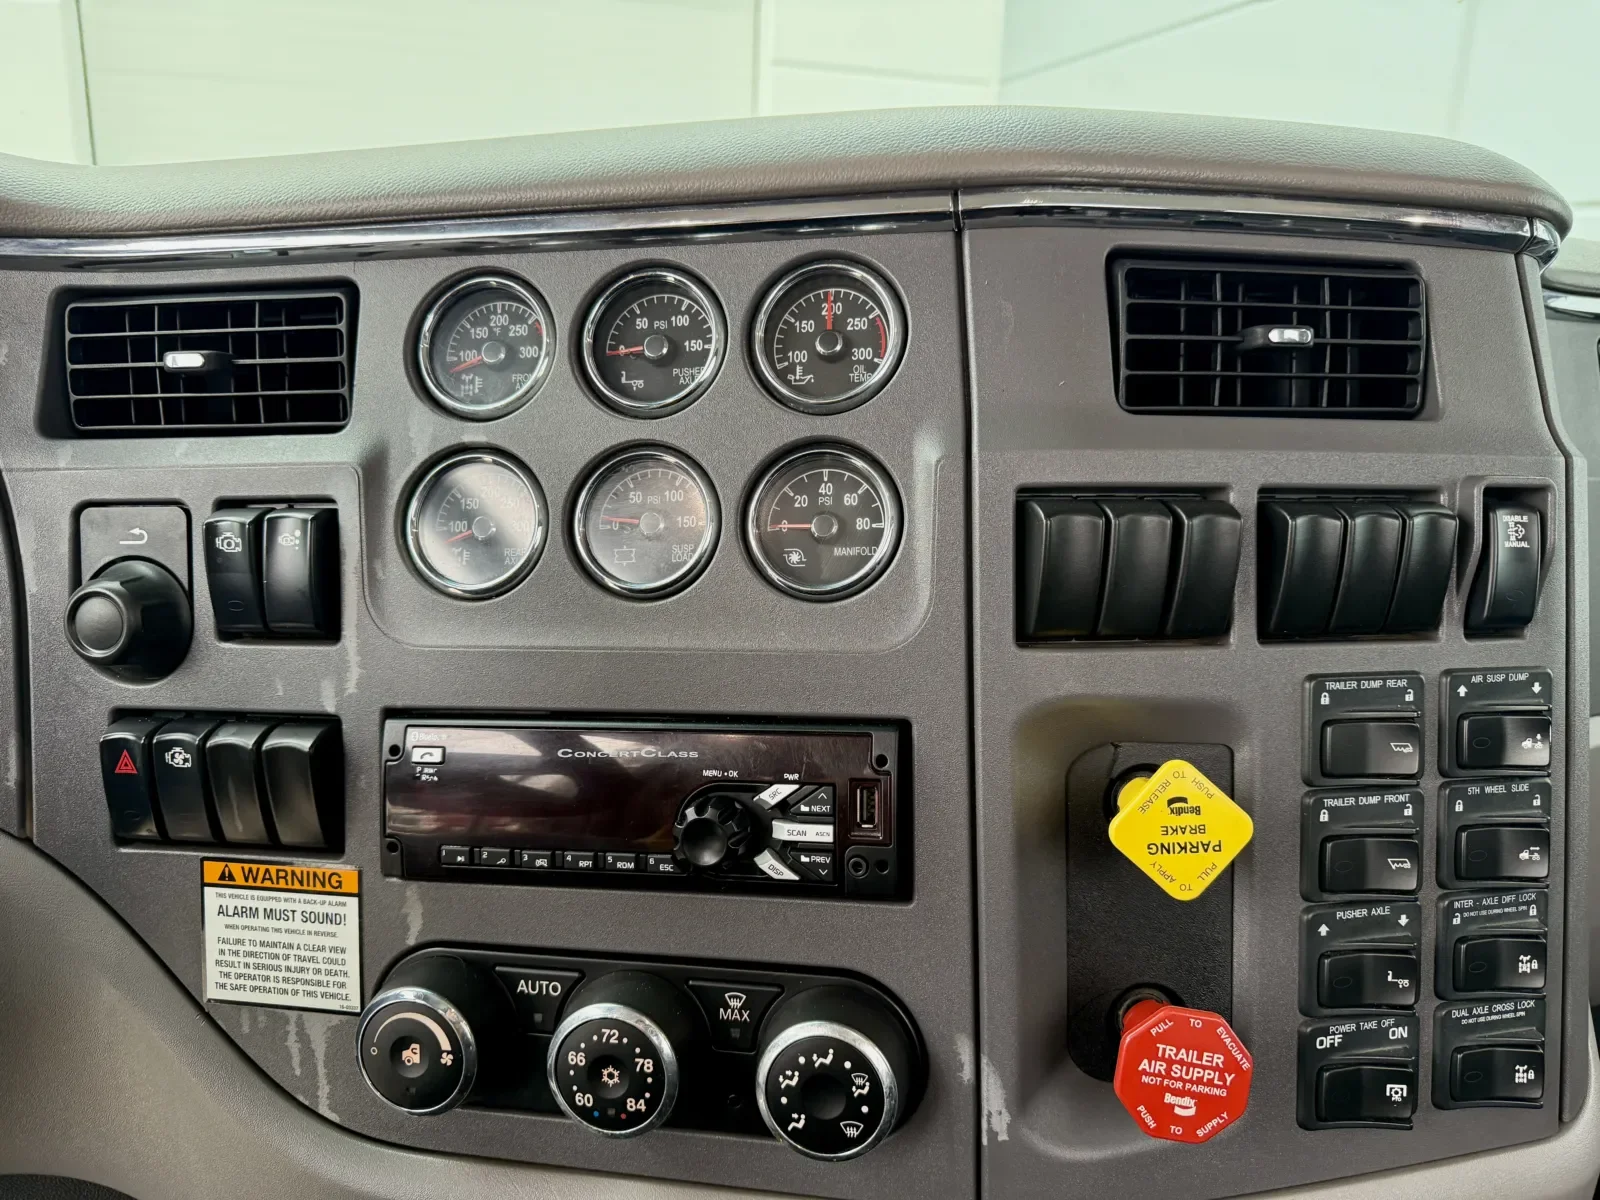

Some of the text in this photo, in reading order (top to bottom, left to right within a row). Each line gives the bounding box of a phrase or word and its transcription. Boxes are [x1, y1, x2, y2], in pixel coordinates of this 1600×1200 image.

[490, 314, 509, 326] 200
[635, 318, 648, 330] 50
[654, 321, 668, 329] PSI
[670, 316, 689, 327] 100
[795, 320, 815, 332] 150
[847, 318, 868, 330] 250
[470, 328, 488, 339] 150
[509, 326, 528, 336] 250
[684, 340, 703, 352] 150
[459, 350, 477, 361] 100
[519, 347, 538, 358] 300
[788, 351, 808, 363] 100
[851, 348, 873, 360] 300
[853, 365, 867, 374] OIL
[818, 483, 833, 494] 40
[629, 491, 642, 502] 50
[647, 495, 661, 504] PSI
[664, 490, 684, 501] 100
[794, 495, 808, 507] 20
[818, 496, 833, 505] PSI
[844, 493, 858, 506] 60
[460, 498, 479, 509] 150
[449, 521, 468, 532] 100
[612, 519, 619, 531] 0
[676, 516, 696, 527] 150
[856, 518, 870, 530] 80
[672, 544, 695, 553] SUSP
[834, 546, 878, 556] MANIFOLD
[1471, 673, 1529, 683] AIR SUSP DUMP
[1325, 679, 1407, 691] TRAILER DUMP REAR
[703, 769, 722, 777] MENU
[769, 788, 782, 800] SRC
[1137, 771, 1215, 814] PUSH TO RELEASE
[1468, 784, 1529, 795] 5TH WHEEL SLIDE
[1323, 794, 1410, 807] TRAILER DUMP FRONT
[811, 805, 830, 813] NEXT
[1168, 806, 1201, 816] Bendix
[787, 829, 807, 837] SCAN
[1161, 824, 1206, 835] BRAKE
[1147, 840, 1222, 856] PARKING
[579, 860, 593, 868] RPT
[811, 855, 830, 864] PREV
[768, 863, 784, 877] DISP
[1150, 861, 1176, 883] APPLY
[1196, 862, 1218, 881] PULL
[241, 866, 343, 890] WARNING
[1454, 893, 1536, 908] INTER AXLE DIFF LOCK
[217, 905, 347, 925] ALARM MUST SOUND!
[1336, 906, 1390, 919] PUSHER AXLE
[241, 925, 270, 933] OPERATING
[217, 937, 247, 946] FAILURE
[248, 939, 257, 947] TO
[259, 940, 294, 950] MAINTAIN
[303, 943, 326, 952] CLEAR
[328, 946, 346, 954] VIEW
[228, 949, 241, 957] THE
[243, 950, 280, 960] DIRECTION
[282, 953, 291, 961] OF
[293, 954, 320, 964] TRAVEL
[323, 957, 346, 966] COULD
[215, 960, 241, 969] RESULT
[252, 963, 282, 972] SERIOUS
[285, 965, 310, 975] INJURY
[313, 967, 322, 975] OR
[325, 968, 350, 978] DEATH.
[219, 971, 347, 989] THE OPERATOR IS RESPONSIBLE FOR
[215, 982, 351, 1001] THE SAFE OPERATION OF THIS VEHICLE.
[517, 979, 562, 996] AUTO
[1452, 1000, 1535, 1018] DUAL AXLE CROSS LOCK
[719, 1008, 750, 1023] MAX
[1329, 1019, 1395, 1034] POWER TAKE OFF
[601, 1029, 619, 1044] 72
[1389, 1027, 1407, 1040] ON
[1150, 1019, 1250, 1071] PULL TO EVACUATE
[1316, 1035, 1342, 1049] OFF
[567, 1051, 586, 1066] 66
[1156, 1044, 1224, 1068] TRAILER
[635, 1058, 654, 1073] 78
[1138, 1058, 1235, 1087] AIR SUPPLY
[1142, 1075, 1227, 1097] NOT FOR PARKING
[575, 1092, 593, 1107] 60
[626, 1098, 646, 1113] 84
[1164, 1093, 1195, 1107] Bendix
[1136, 1105, 1228, 1138] PUSH TO SUPPLY
